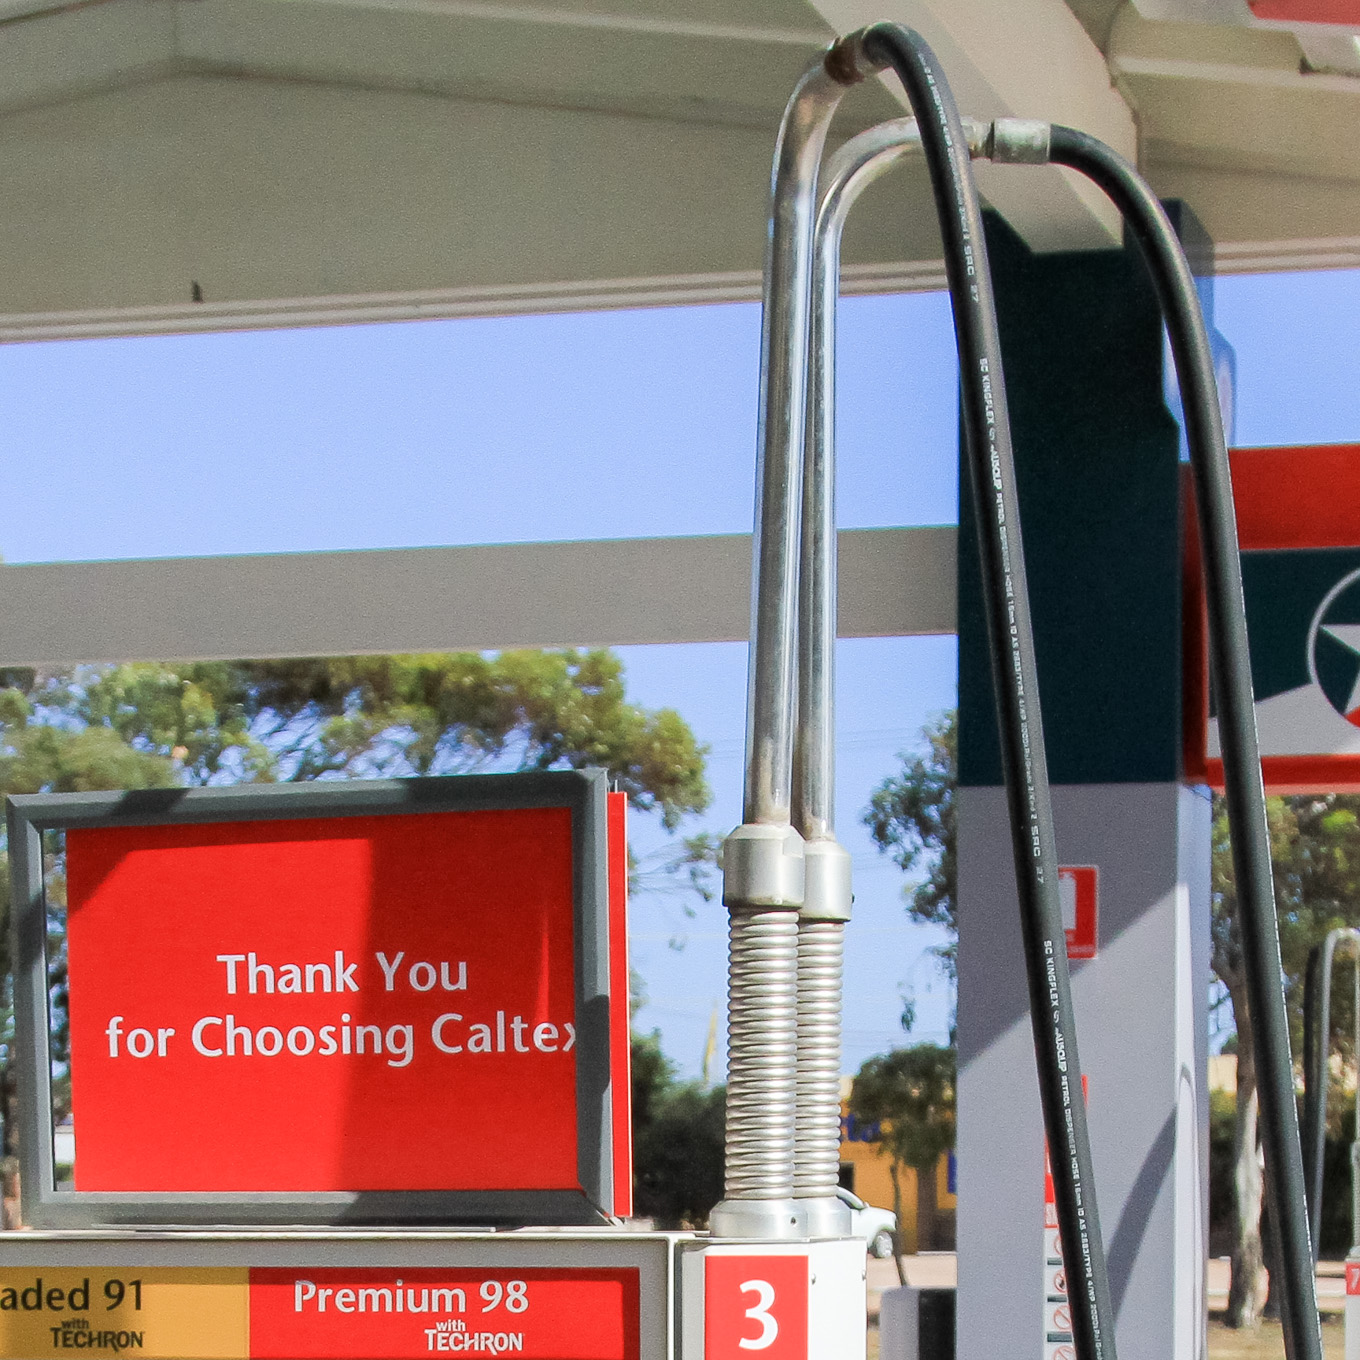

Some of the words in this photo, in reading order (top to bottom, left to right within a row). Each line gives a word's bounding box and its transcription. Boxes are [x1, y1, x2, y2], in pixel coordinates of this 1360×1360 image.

[978, 357, 988, 372] SC
[980, 374, 994, 424] KINGFLEX
[994, 492, 1005, 524] PETROL
[1042, 939, 1053, 954] SC
[216, 951, 359, 994] Thank
[375, 952, 468, 991] You
[1045, 957, 1060, 1006] KINGFLEX
[105, 1017, 175, 1058] for
[191, 1013, 414, 1067] Choosing
[1054, 1031, 1068, 1071] AUSQUIP
[1060, 1074, 1071, 1106] PETROL
[1070, 1156, 1080, 1179] HOSE
[1073, 1181, 1083, 1206] 16mm
[1077, 1217, 1086, 1230] AS
[1350, 1269, 1360, 1290] 7
[104, 1278, 142, 1311] 91
[294, 1279, 466, 1313] Premium
[479, 1280, 529, 1314] 98
[61, 1318, 89, 1330] with
[436, 1318, 466, 1332] with
[738, 1279, 780, 1350] 3
[50, 1327, 144, 1352] TECHRON
[424, 1329, 524, 1355] TECHRON
